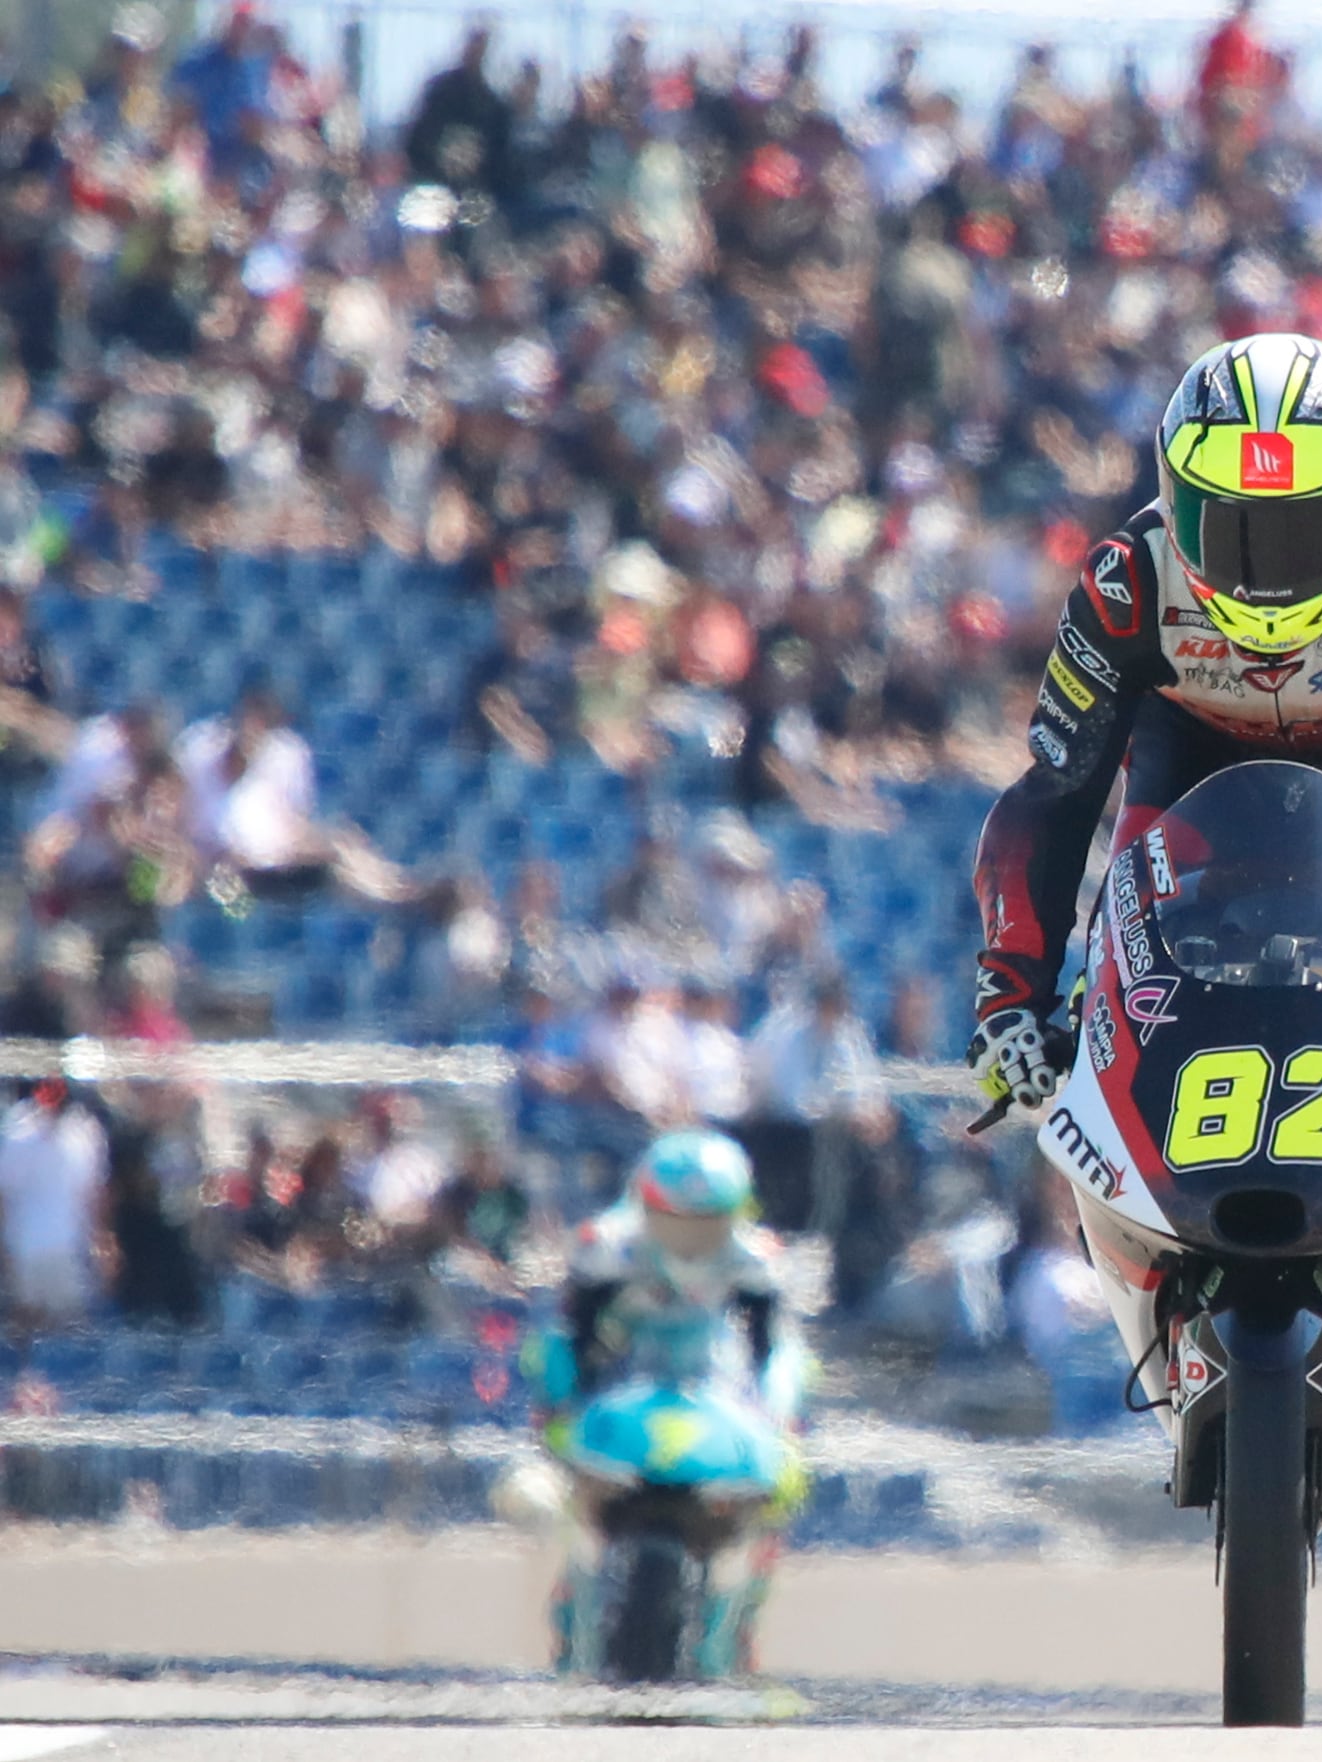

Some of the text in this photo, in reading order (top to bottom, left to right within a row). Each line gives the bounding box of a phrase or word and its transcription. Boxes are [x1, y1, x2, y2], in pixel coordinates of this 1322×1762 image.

[1175, 636, 1231, 660] KTM
[1051, 660, 1089, 703] DUNLOP
[1147, 826, 1176, 896] WRS
[1114, 849, 1154, 979] ANGELUSS
[1093, 1007, 1116, 1067] OLIMPIA
[1186, 1361, 1206, 1380] D
